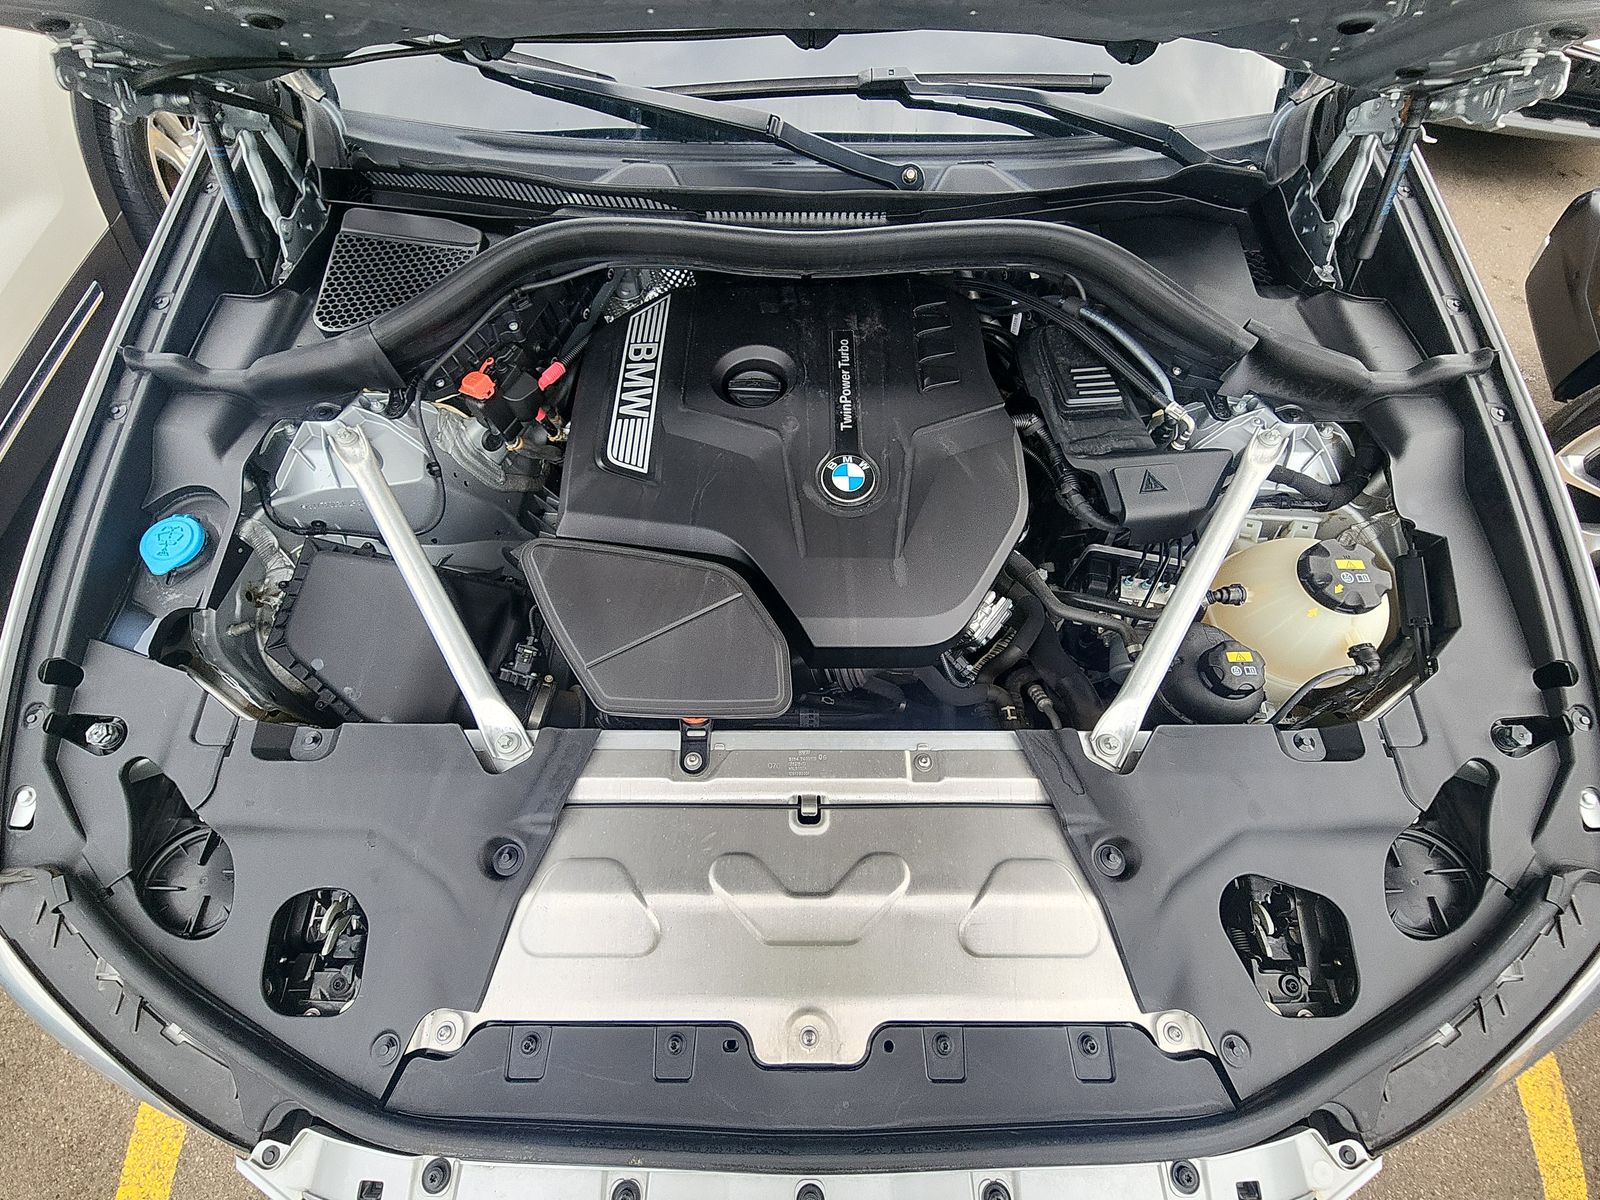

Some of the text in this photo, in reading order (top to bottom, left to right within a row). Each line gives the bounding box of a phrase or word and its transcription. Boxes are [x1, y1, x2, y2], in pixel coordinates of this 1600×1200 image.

[619, 343, 658, 417] BMW
[837, 338, 853, 432] TwinPower Turbo
[826, 456, 870, 471] BMW
